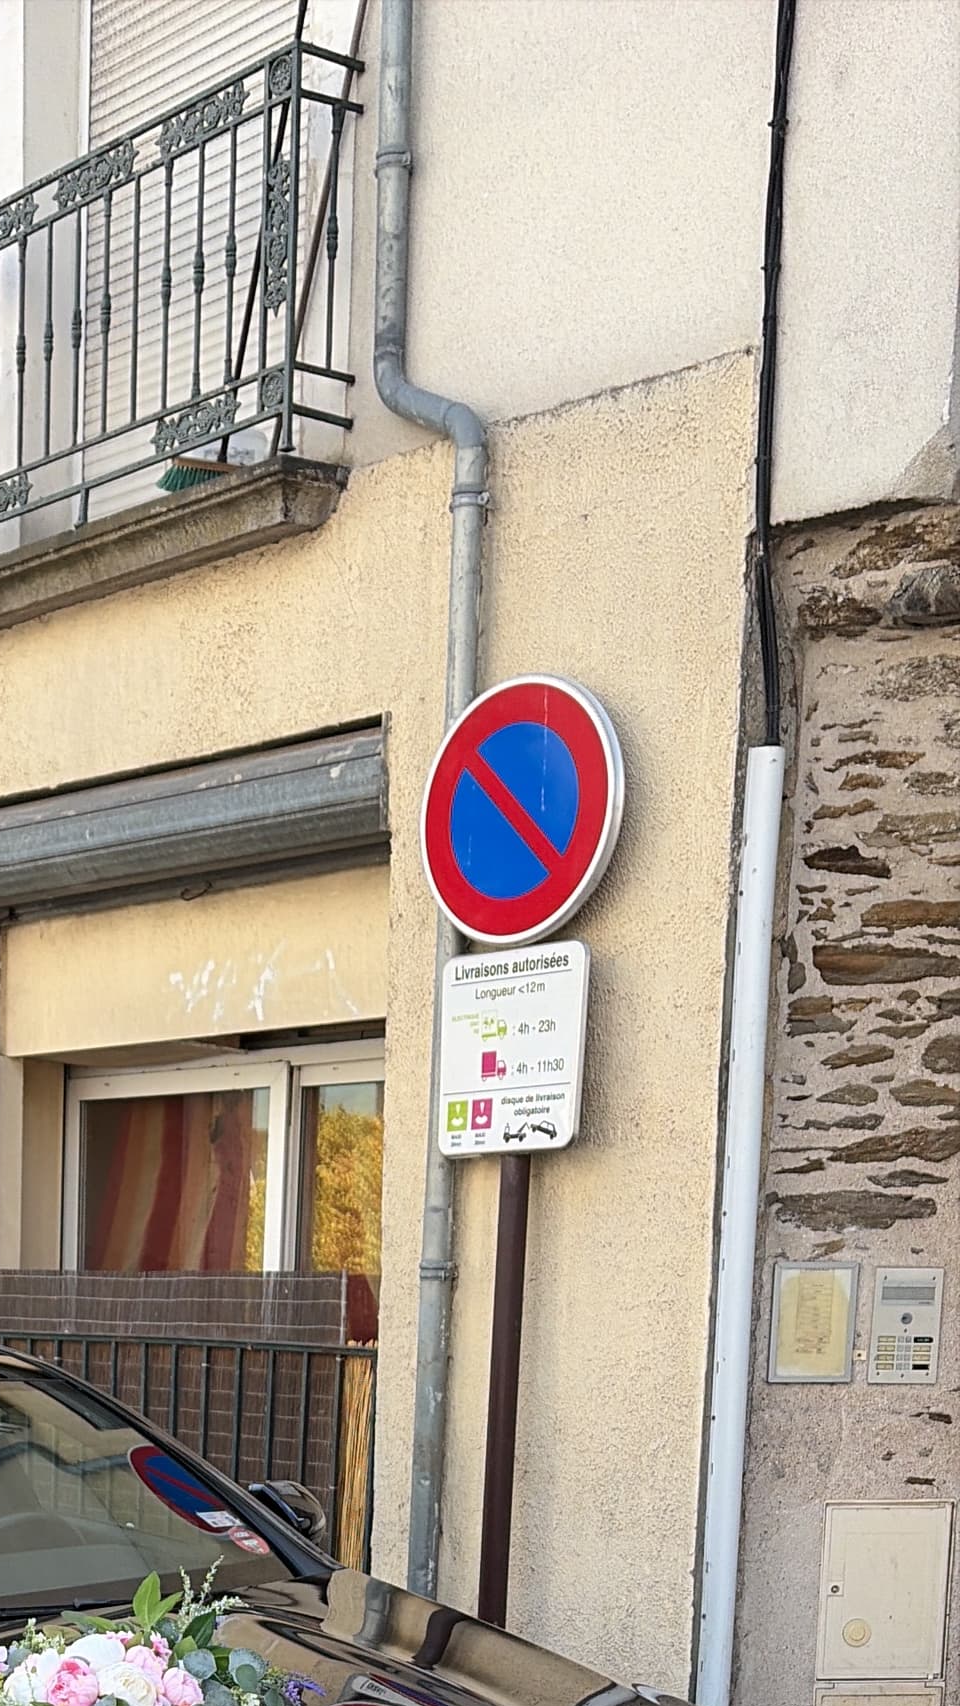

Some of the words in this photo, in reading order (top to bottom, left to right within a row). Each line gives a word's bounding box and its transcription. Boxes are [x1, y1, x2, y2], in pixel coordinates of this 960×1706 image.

[455, 962, 509, 981] Livraisons
[512, 952, 569, 974] autorisées
[475, 985, 516, 1000] Longueur
[518, 1021, 530, 1036] 4h
[538, 1018, 556, 1033] 23h
[516, 1060, 528, 1075] 4h
[537, 1058, 565, 1073] 11h30
[525, 1094, 534, 1103] de
[536, 1092, 565, 1102] livraison
